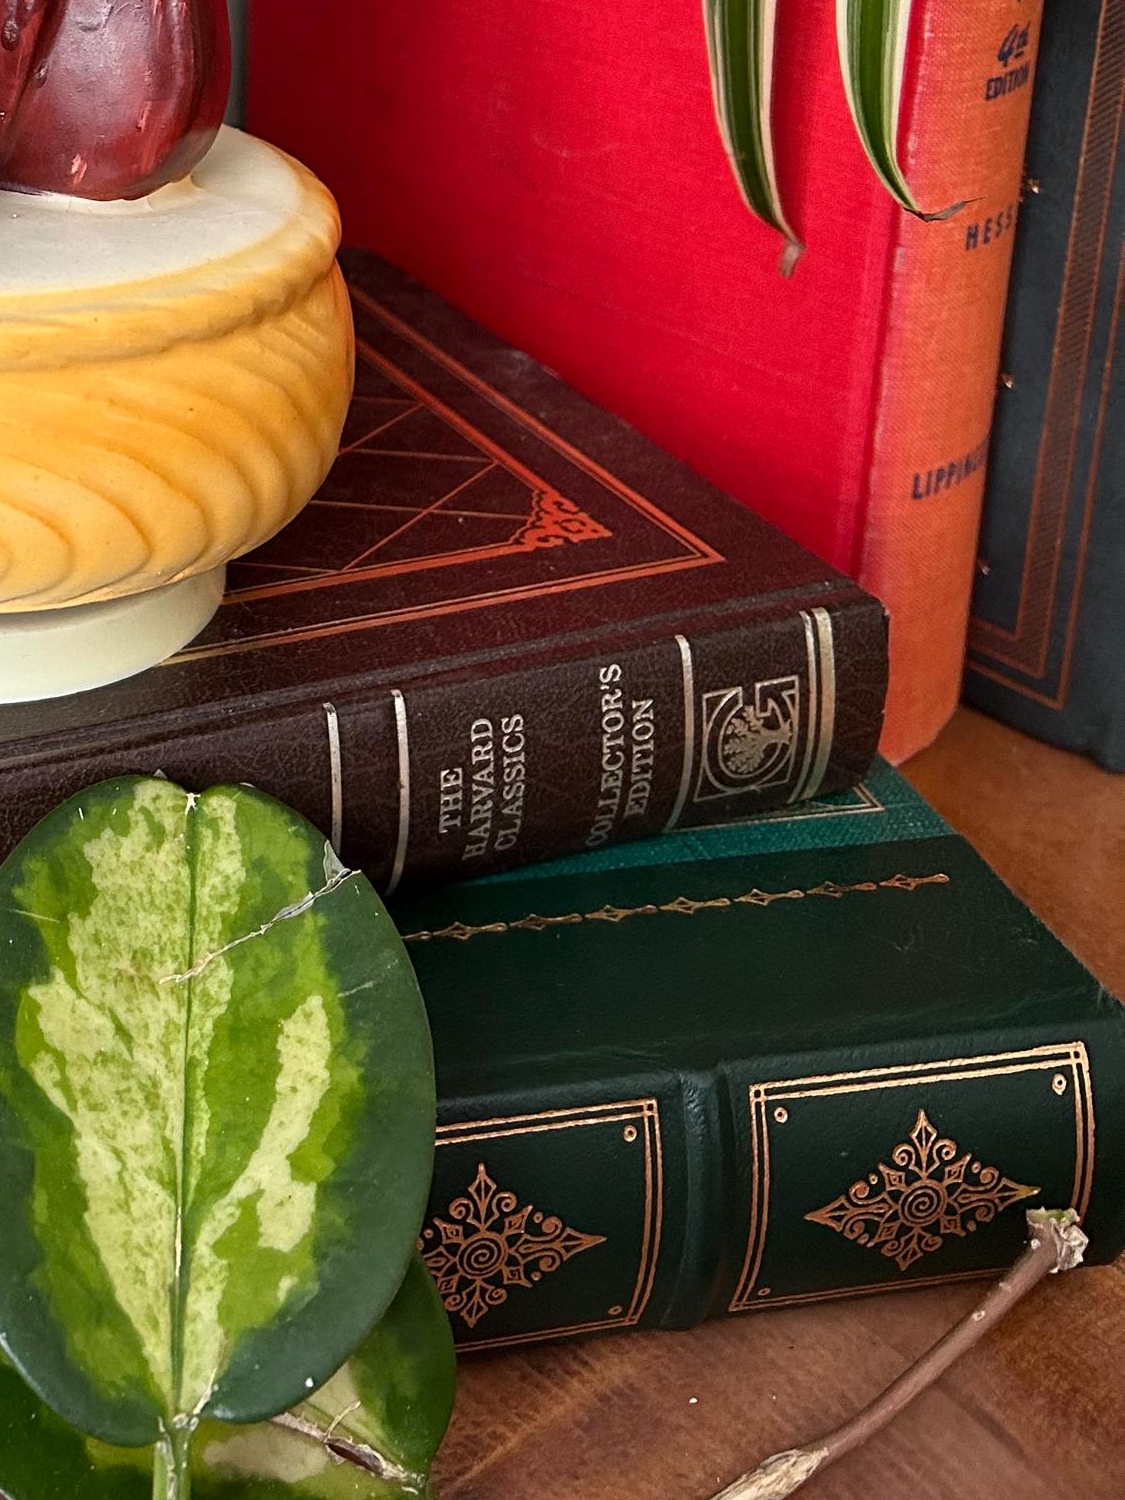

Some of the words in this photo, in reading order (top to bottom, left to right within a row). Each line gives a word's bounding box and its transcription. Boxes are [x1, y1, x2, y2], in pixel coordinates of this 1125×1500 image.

[985, 62, 1029, 101] EDITION
[965, 205, 1013, 251] HESS
[439, 767, 463, 833] THE
[462, 718, 494, 861] HARVARD
[494, 714, 525, 851] CLASSICS
[585, 663, 624, 847] COLLECTOR'S
[625, 699, 655, 817] EDITION
